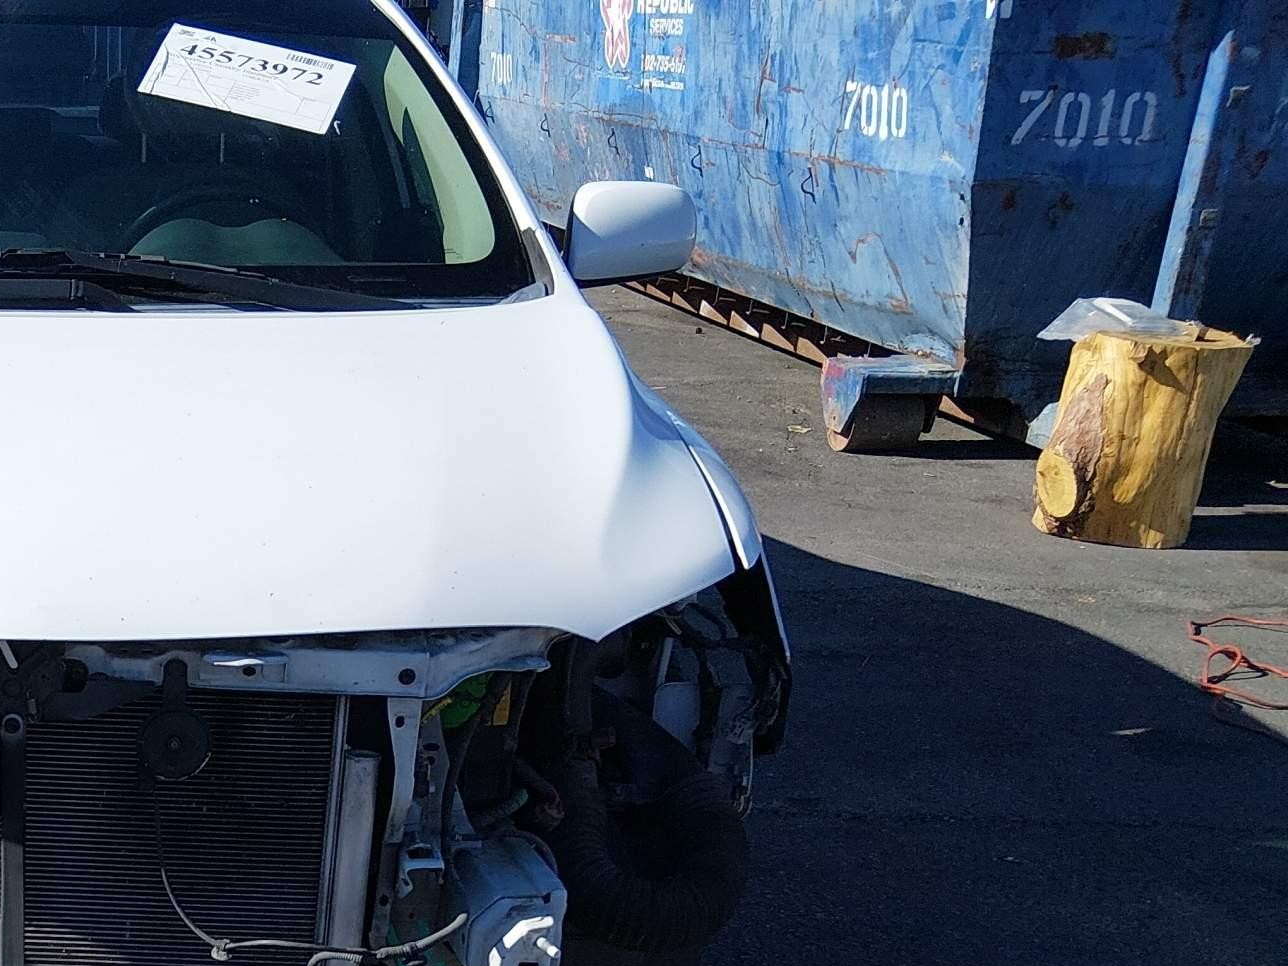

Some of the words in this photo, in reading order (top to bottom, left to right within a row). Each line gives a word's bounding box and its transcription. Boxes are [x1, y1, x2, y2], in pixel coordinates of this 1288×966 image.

[636, 0, 693, 14] REPUBLIC
[649, 17, 684, 36] SERVICES
[180, 44, 324, 86] 45573972
[490, 51, 513, 84] 7010
[844, 80, 908, 140] 7010
[1011, 88, 1158, 148] 7010
